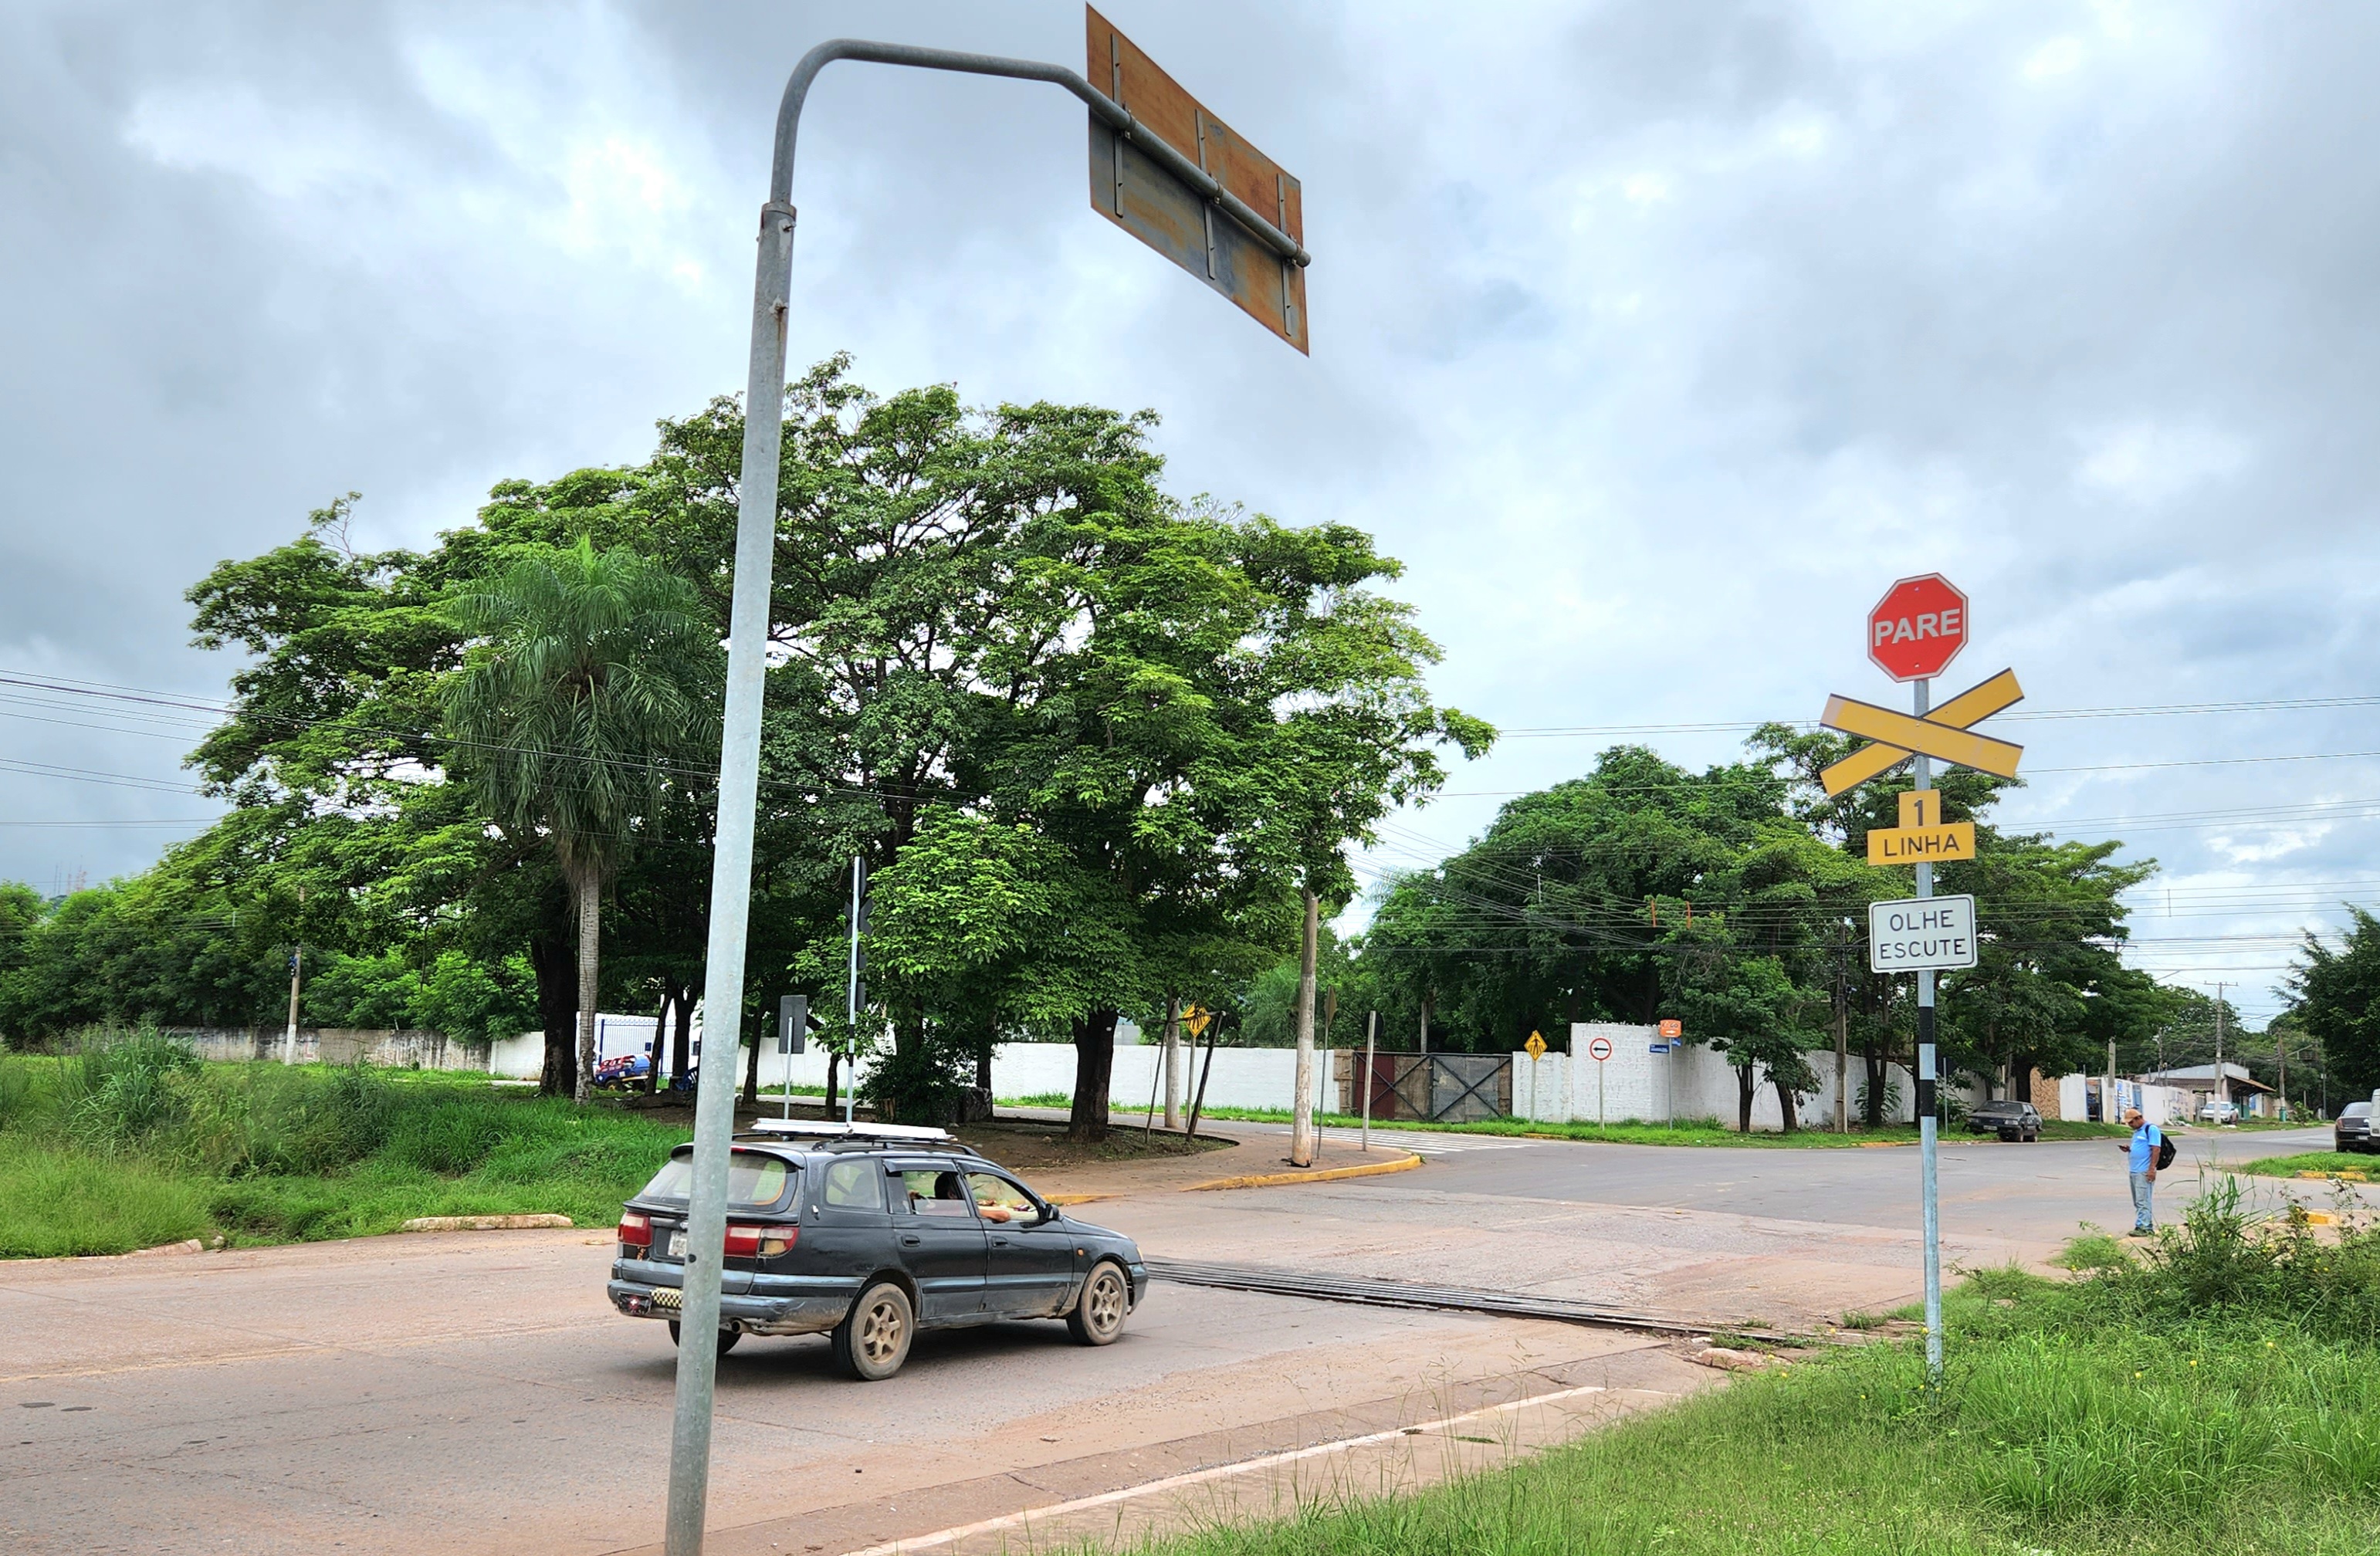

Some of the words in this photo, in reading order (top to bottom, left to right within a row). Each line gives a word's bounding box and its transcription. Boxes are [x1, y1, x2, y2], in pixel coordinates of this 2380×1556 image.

[1875, 608, 1961, 646] PARE
[1914, 800, 1924, 826] 1
[1884, 834, 1960, 857] LINHA
[1889, 909, 1955, 932] OLHE
[1880, 938, 1967, 960] ESCUTE
